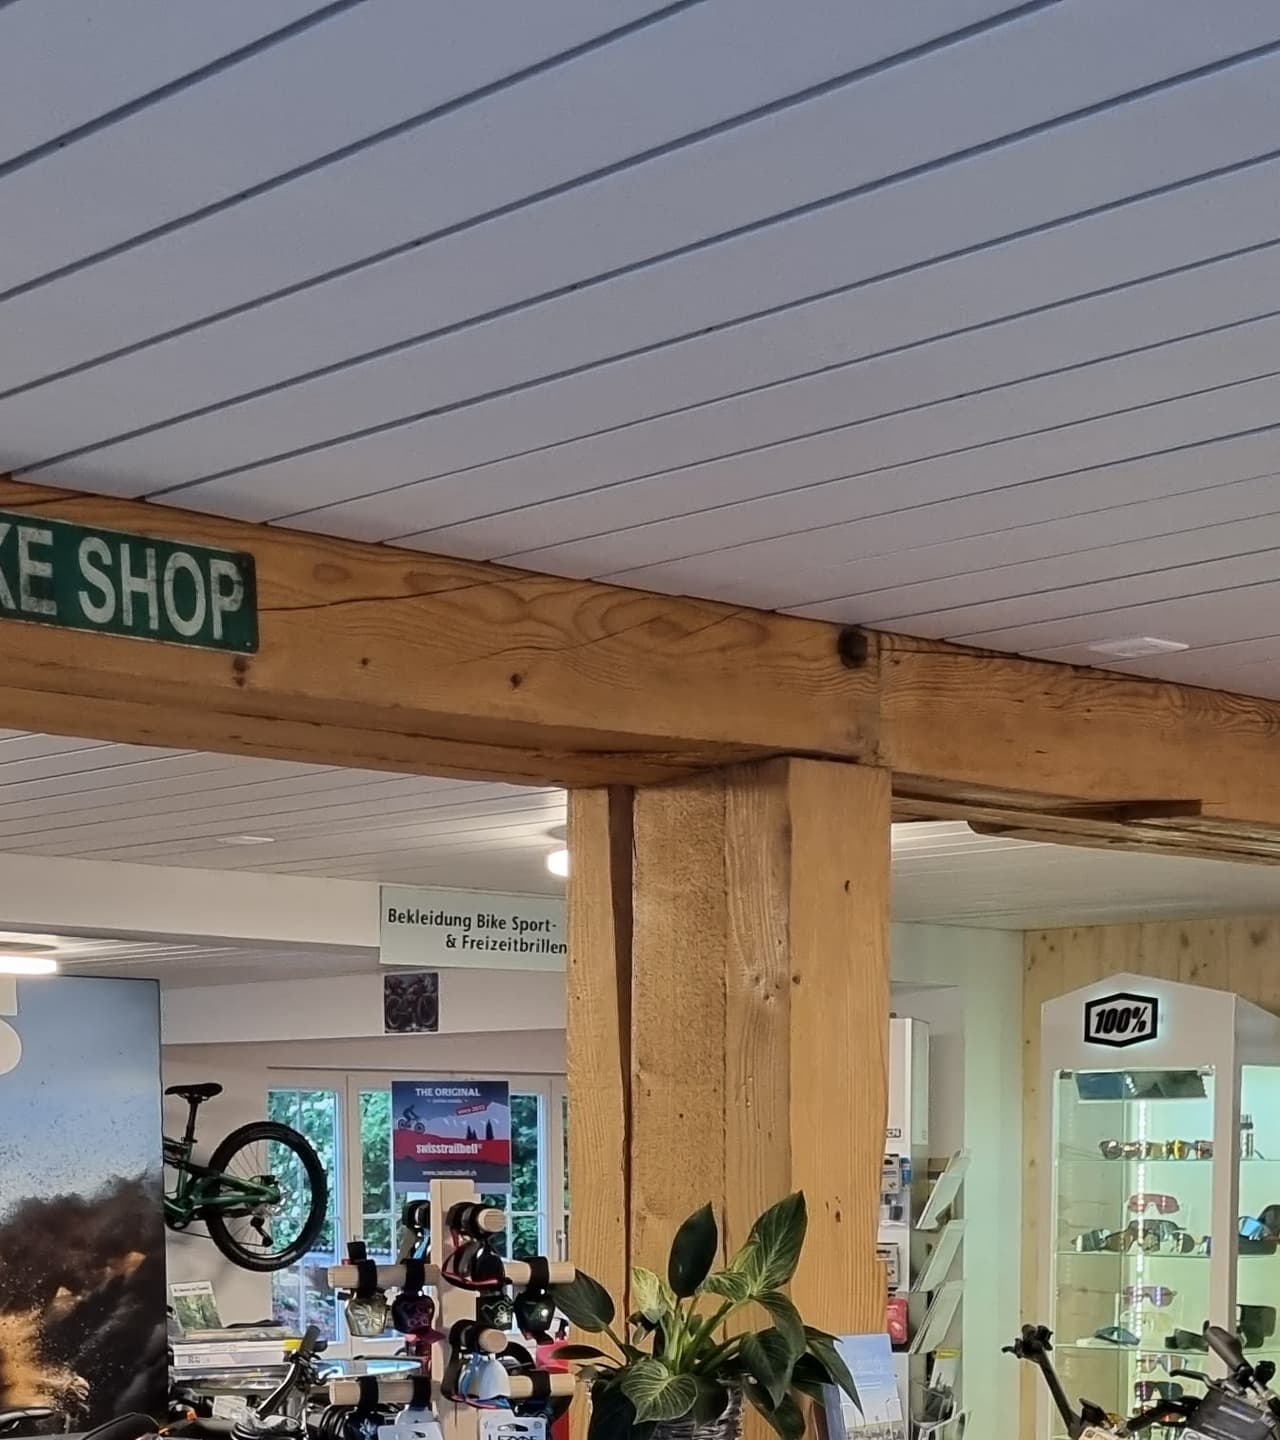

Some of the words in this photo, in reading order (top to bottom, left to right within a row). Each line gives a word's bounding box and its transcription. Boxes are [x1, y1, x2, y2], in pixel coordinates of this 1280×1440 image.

[77, 536, 245, 641] SHOP
[387, 907, 471, 932] Bekleidung
[477, 913, 507, 930] Bike
[512, 915, 557, 935] Sport-
[446, 934, 457, 949] &
[462, 934, 568, 955] Freizeitbrillen
[1093, 1006, 1148, 1034] 100%
[415, 1087, 434, 1097] THE
[434, 1087, 481, 1097] ORIGINAL
